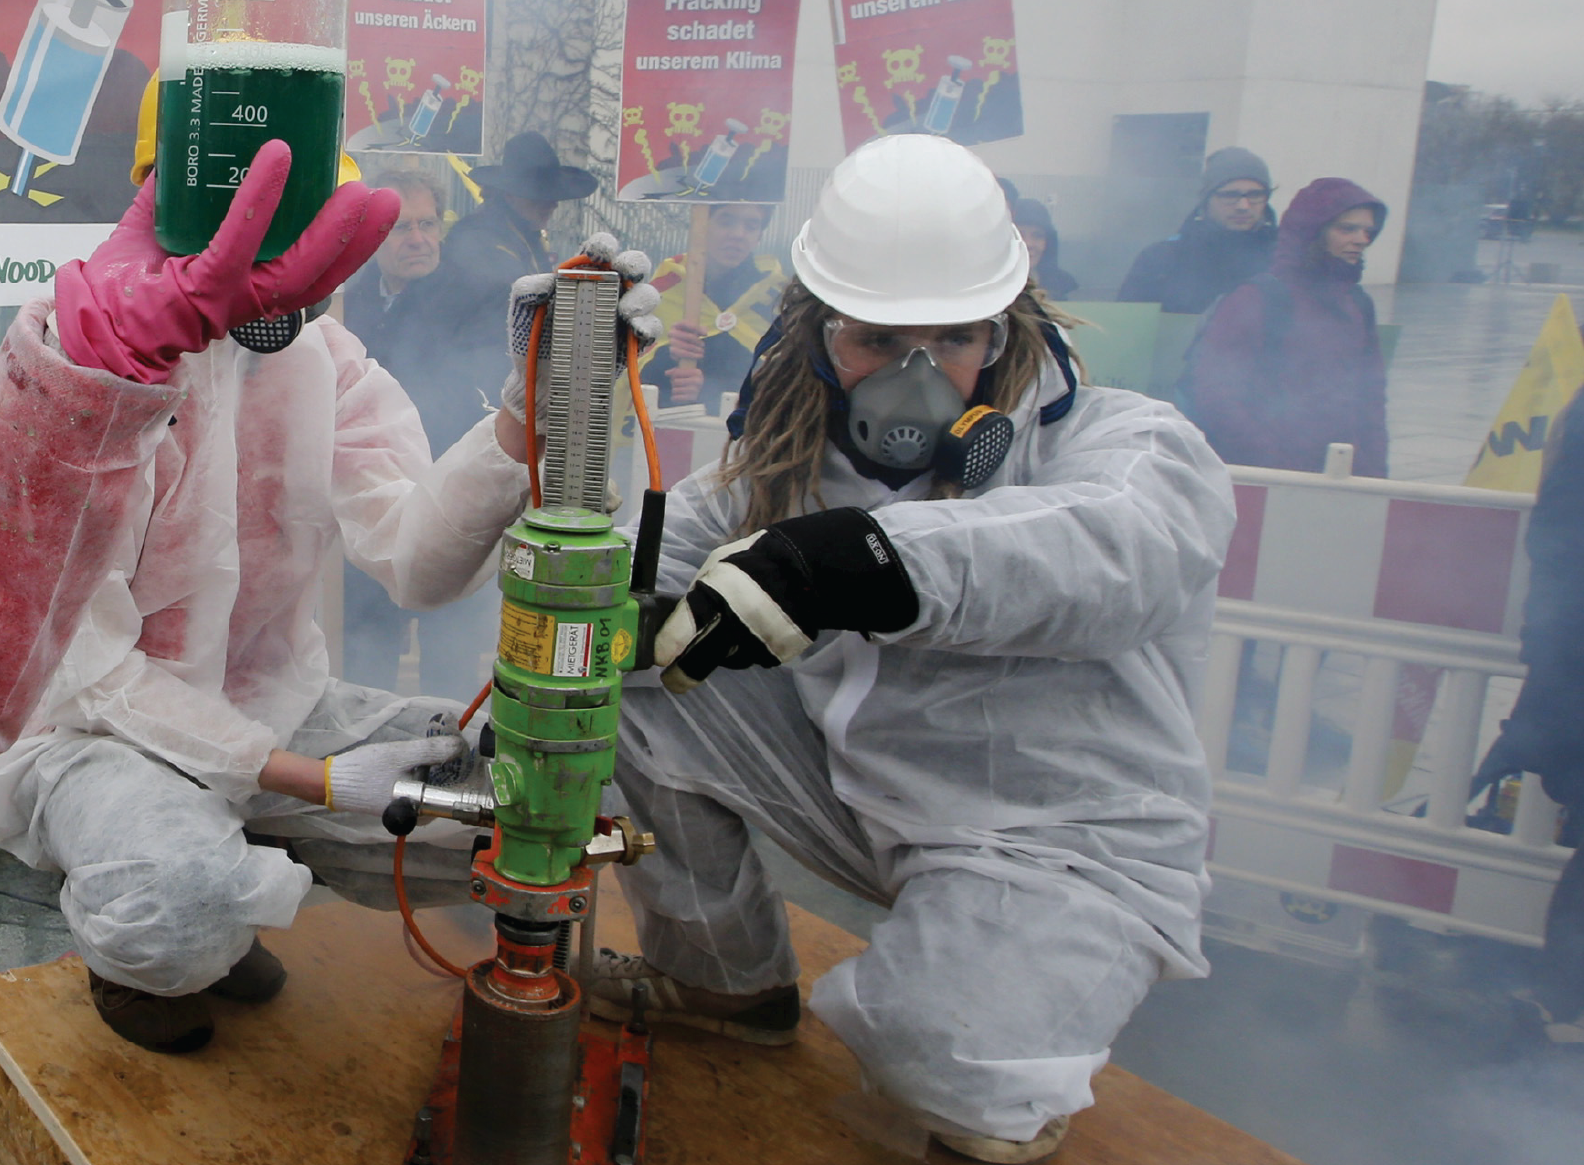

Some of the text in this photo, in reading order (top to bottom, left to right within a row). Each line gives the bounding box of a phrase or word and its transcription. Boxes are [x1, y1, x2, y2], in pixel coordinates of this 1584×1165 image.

[354, 9, 477, 33] unseren Äckern
[667, 20, 756, 41] schadet
[635, 51, 783, 71] unserem Klima
[190, 67, 205, 113] MADE
[231, 104, 268, 123] 400
[189, 118, 201, 140] 3.3
[187, 147, 199, 187] BORO
